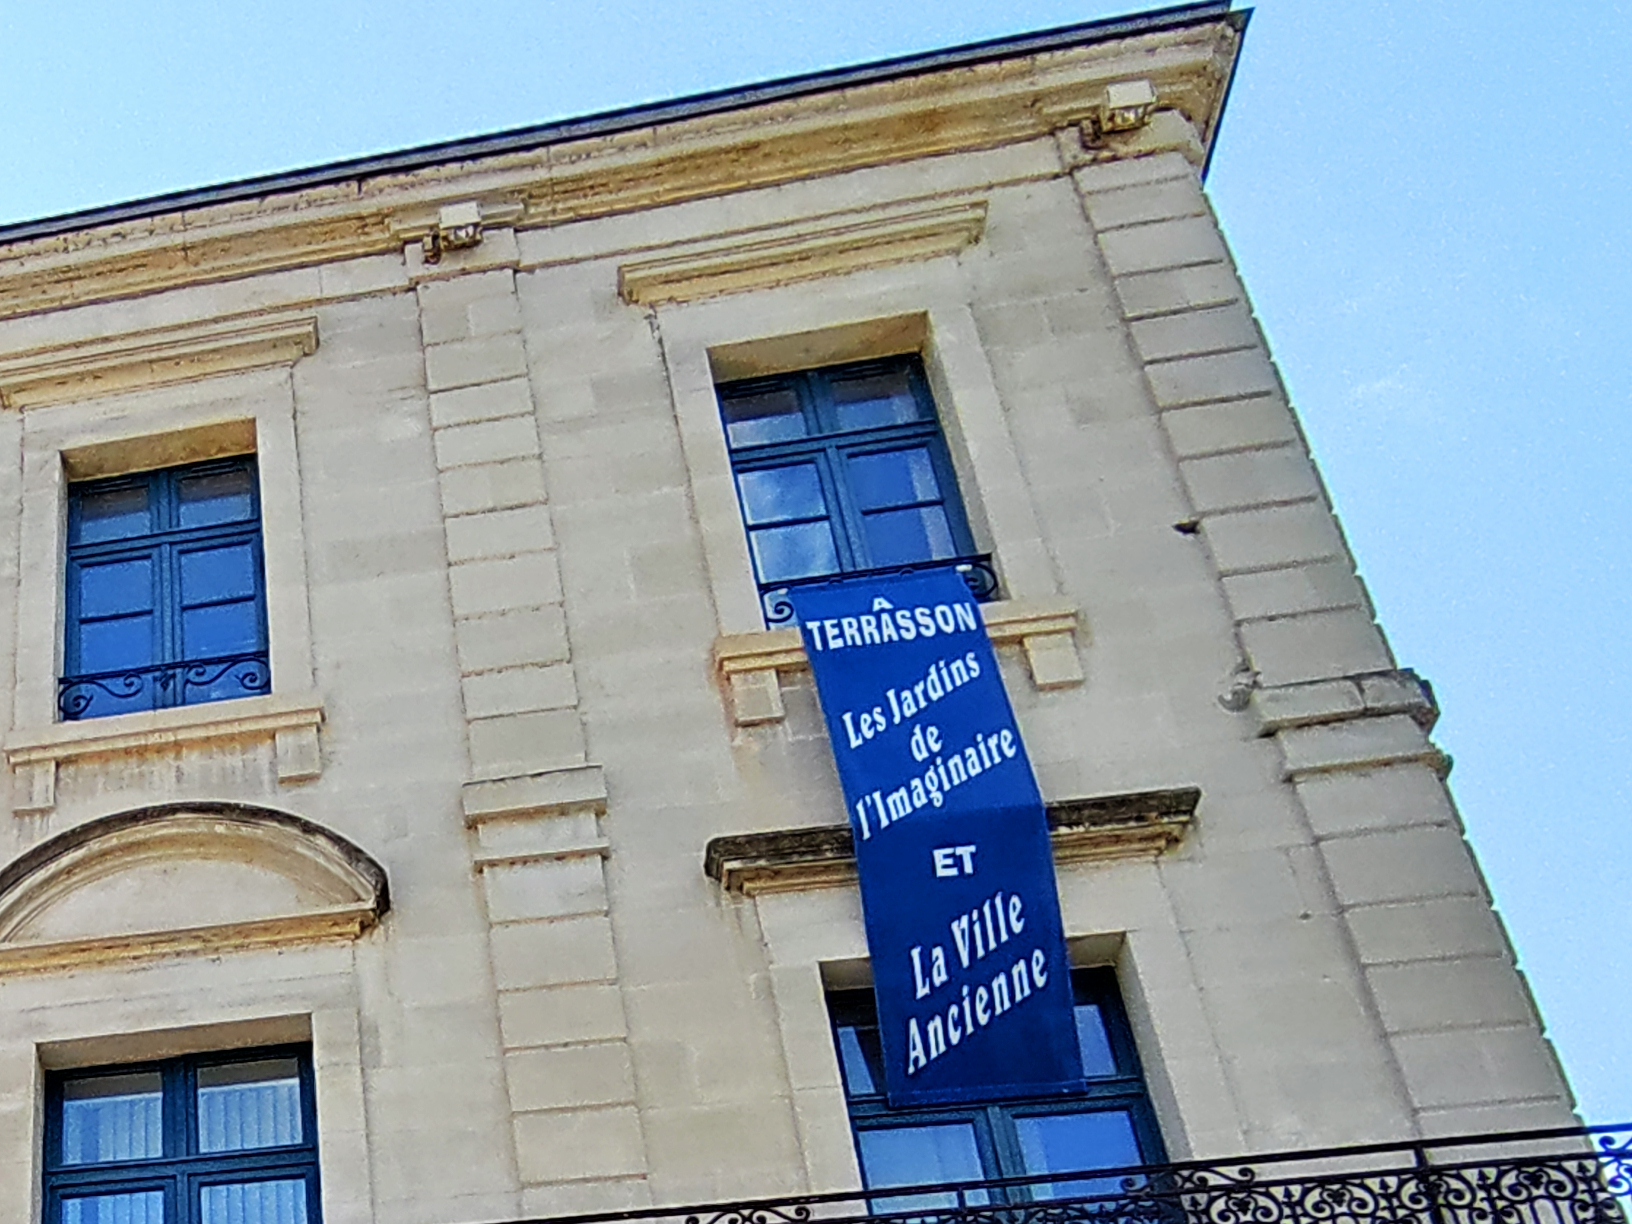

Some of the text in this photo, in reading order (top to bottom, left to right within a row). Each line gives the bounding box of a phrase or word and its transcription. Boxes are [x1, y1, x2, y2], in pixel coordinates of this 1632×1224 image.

[842, 652, 981, 749] Les Jardins
[910, 723, 943, 762] de
[856, 728, 1017, 841] l'Imaginaire
[932, 845, 976, 878] ET
[910, 891, 1025, 1000] La Ville
[908, 949, 1048, 1075] Ancienne
